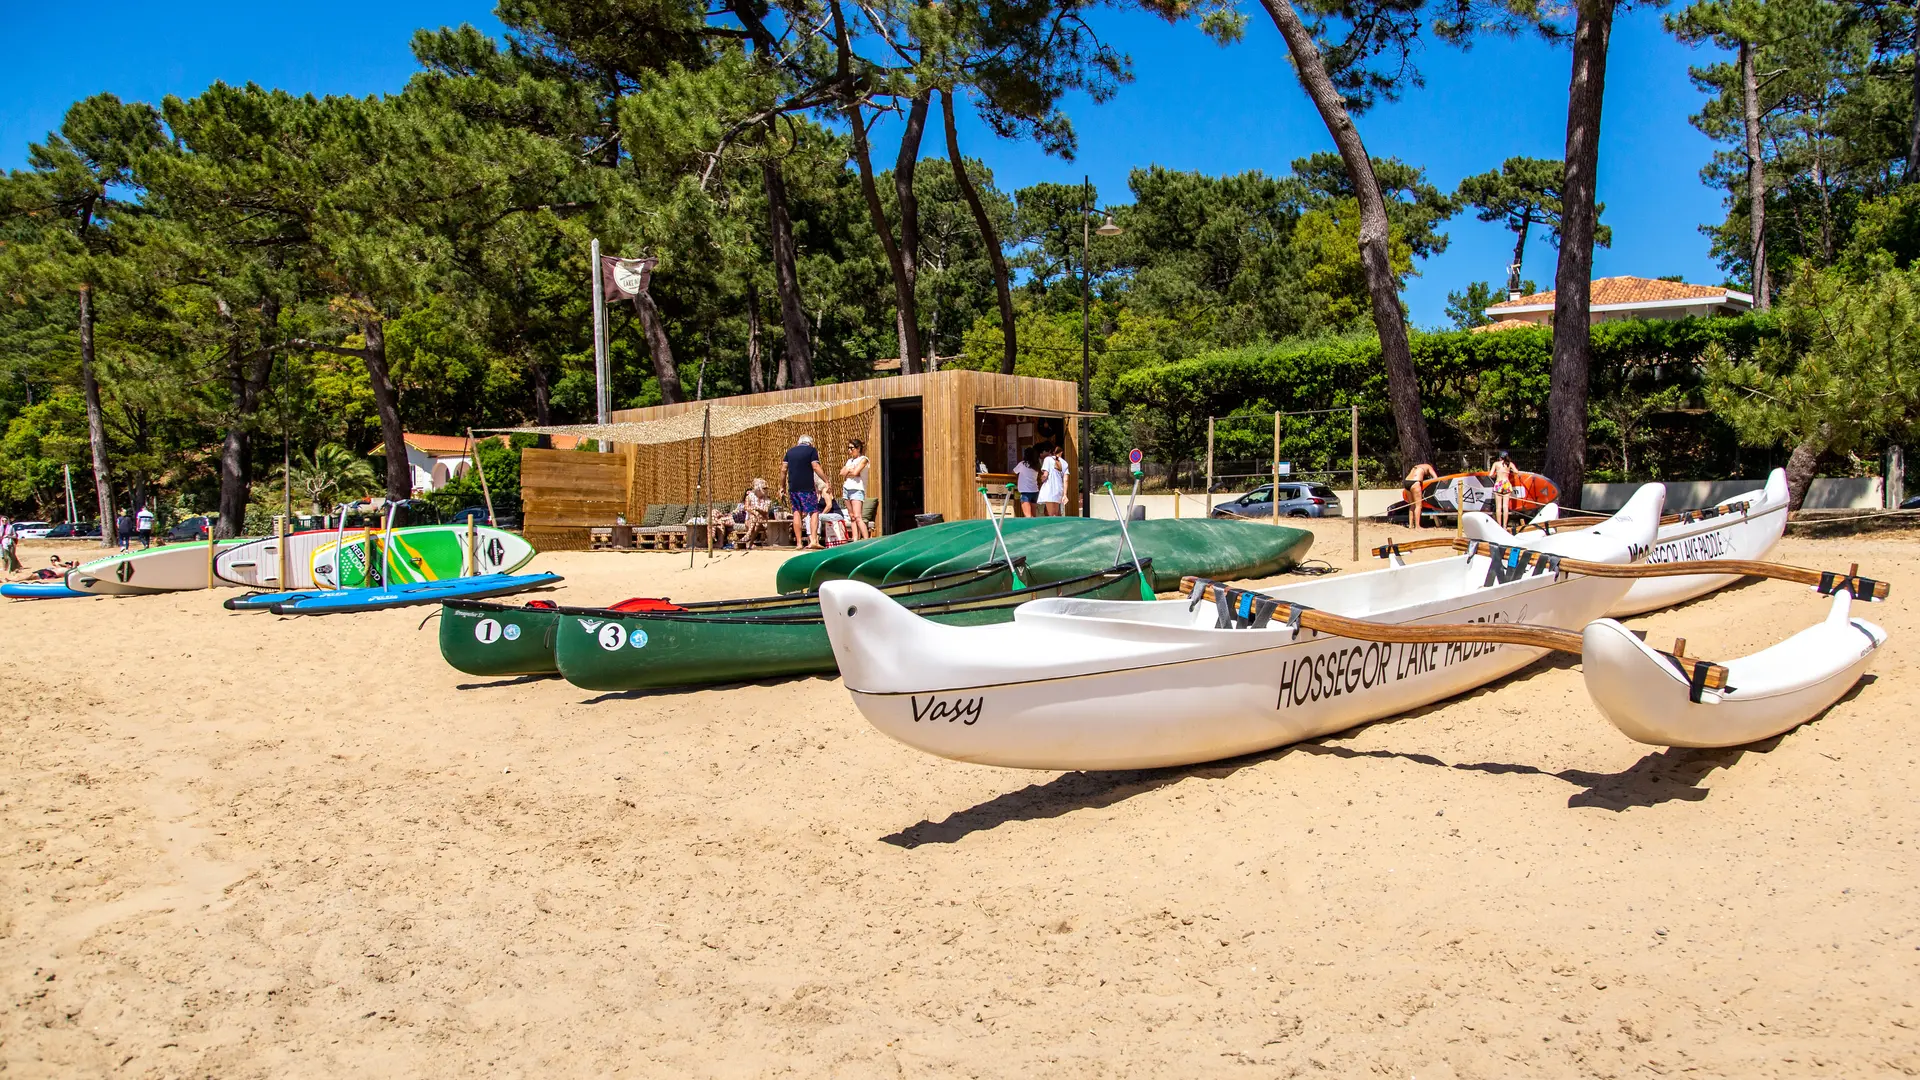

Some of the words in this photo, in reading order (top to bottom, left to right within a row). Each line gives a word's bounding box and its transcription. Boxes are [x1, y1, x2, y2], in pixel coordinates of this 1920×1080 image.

[1680, 538, 1701, 561] LAKE
[1698, 532, 1724, 560] PADDLE
[484, 622, 493, 641] 1
[605, 626, 620, 648] 3
[1277, 642, 1392, 710] HOSSEGOR
[1396, 642, 1439, 680] LAKE
[911, 695, 984, 726] Vasy
